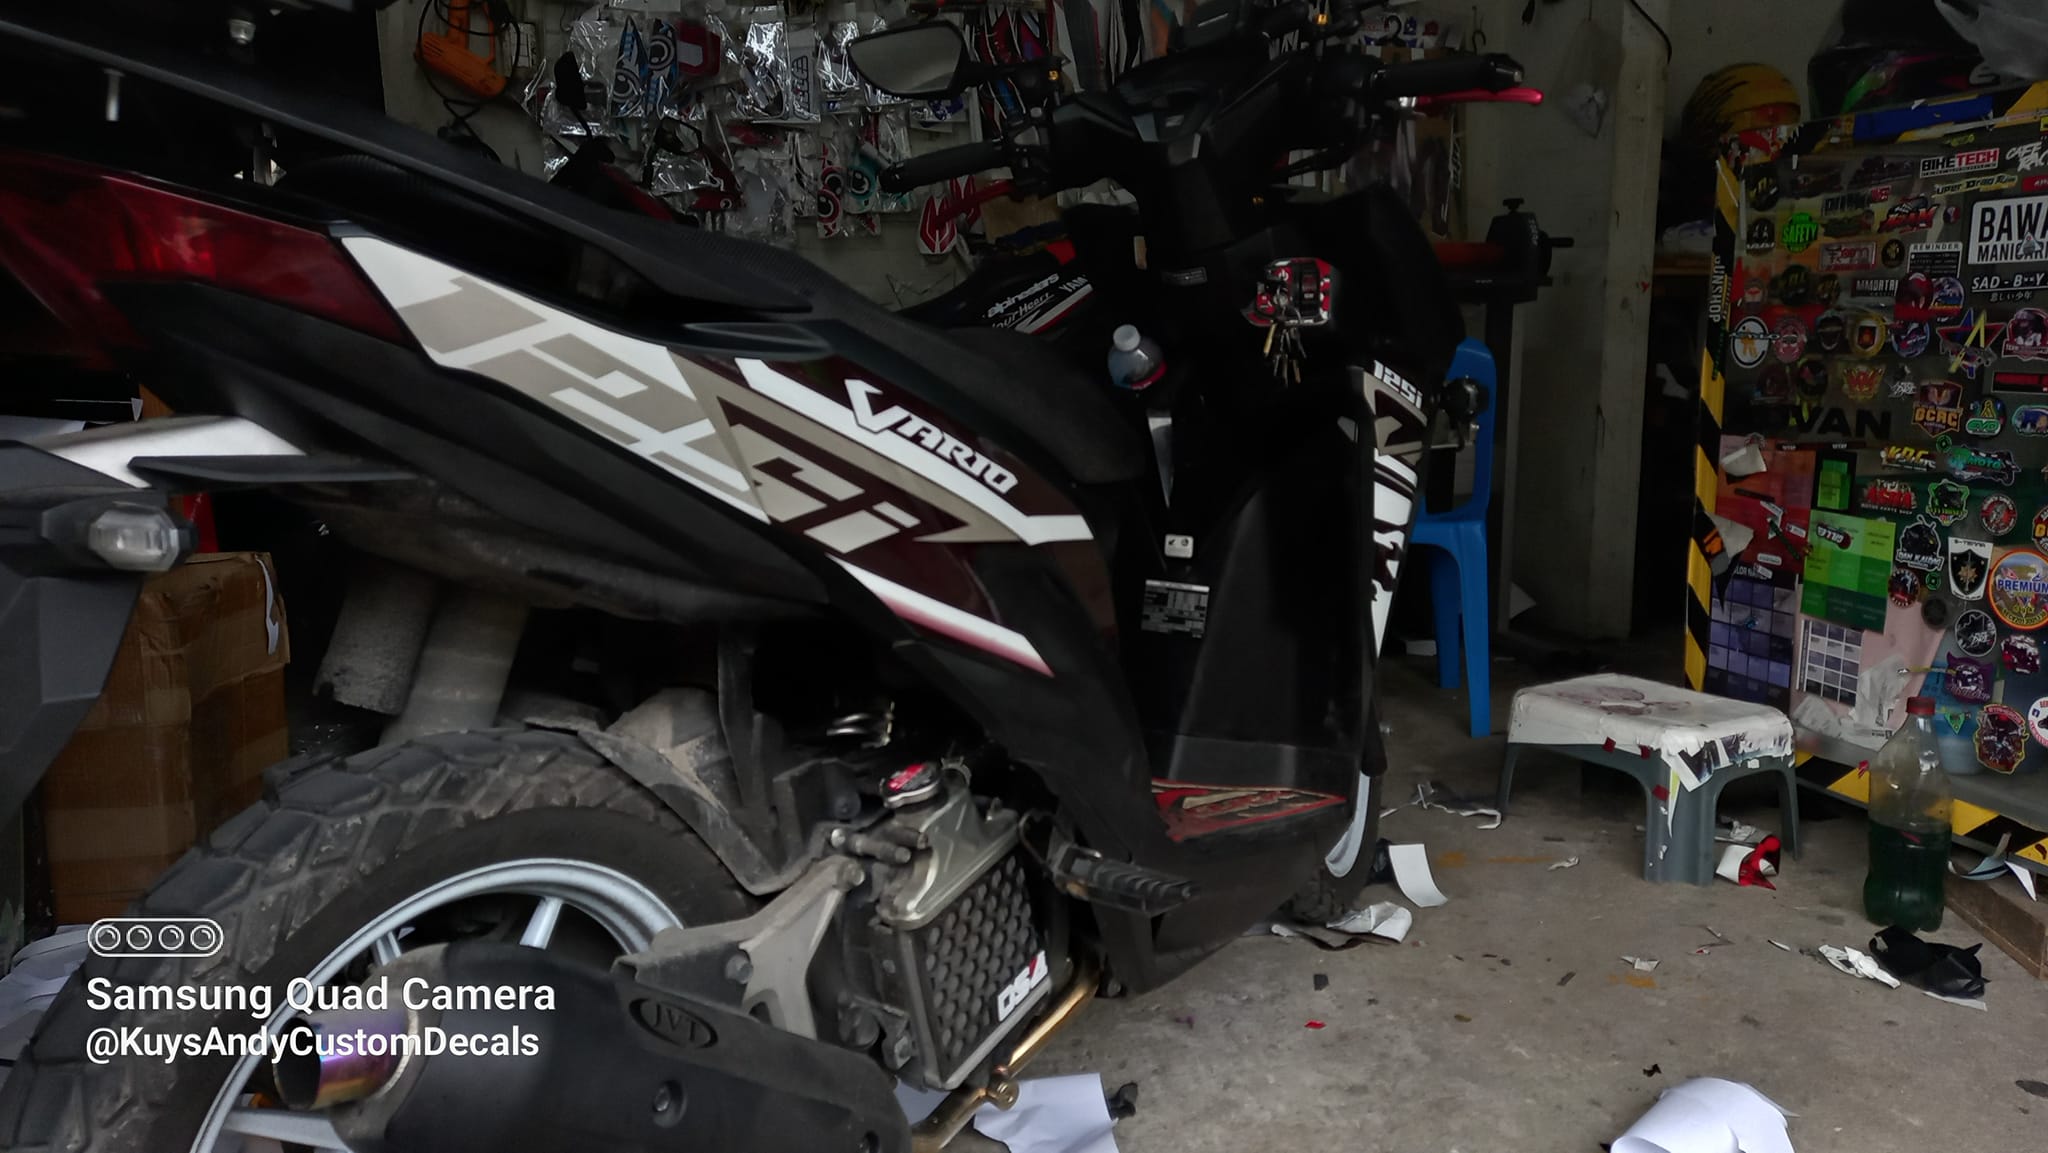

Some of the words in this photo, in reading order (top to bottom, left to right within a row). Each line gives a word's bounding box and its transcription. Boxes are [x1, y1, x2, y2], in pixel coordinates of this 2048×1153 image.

[1783, 224, 1818, 243] SAFETY
[1971, 276, 2001, 290] SAD
[1373, 359, 1424, 409] 125i
[843, 378, 1019, 496] VARIO
